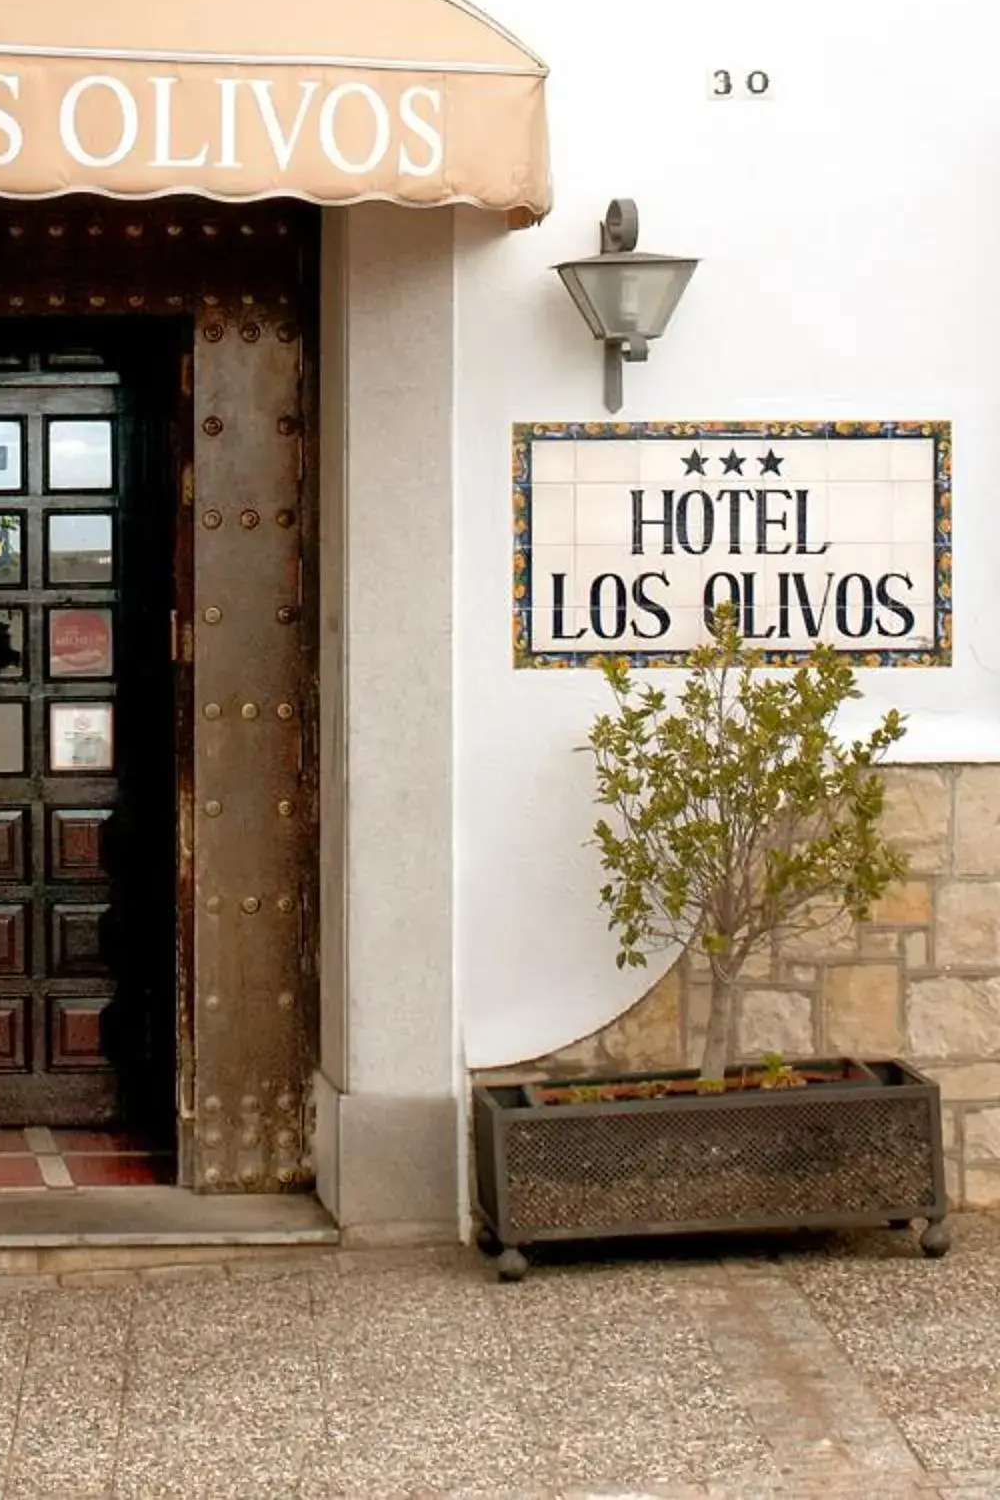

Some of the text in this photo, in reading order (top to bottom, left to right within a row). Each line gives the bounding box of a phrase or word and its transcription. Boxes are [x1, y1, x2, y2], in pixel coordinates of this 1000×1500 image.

[59, 74, 442, 177] OLIVOS
[631, 489, 832, 555] HOTEL
[552, 571, 915, 639] LOS OLIVOS
